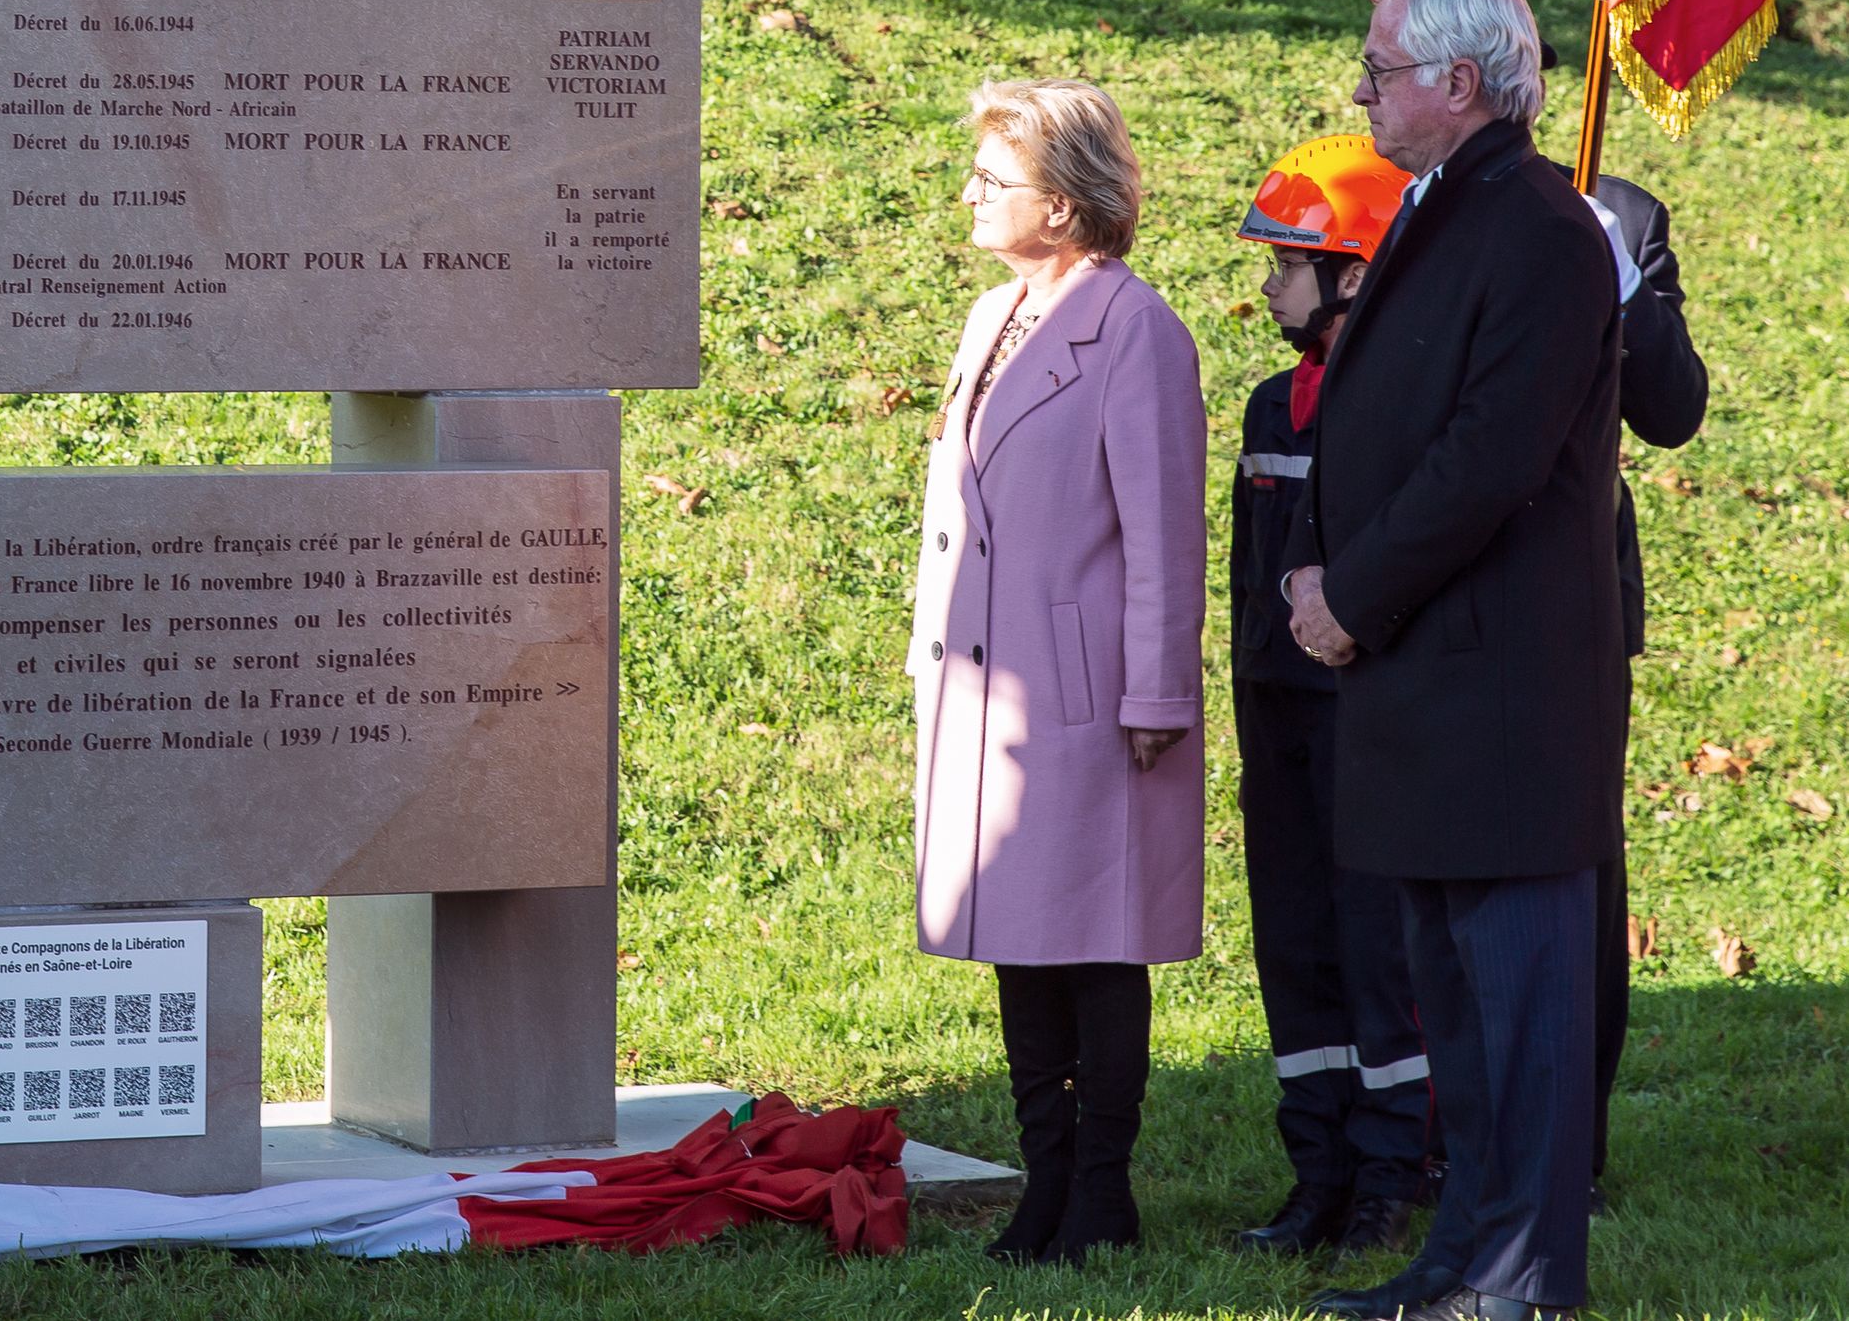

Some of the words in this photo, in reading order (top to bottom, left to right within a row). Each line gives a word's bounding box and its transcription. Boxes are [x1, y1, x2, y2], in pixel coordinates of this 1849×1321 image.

[559, 31, 651, 47] PATRIAM
[550, 54, 659, 71] SERVANDO
[545, 77, 666, 94] VICTORIAM
[574, 102, 637, 118] TULIT
[556, 184, 580, 199] En
[593, 186, 655, 200] servant
[566, 208, 581, 223] la
[595, 208, 646, 228] patrie
[545, 231, 557, 247] il
[570, 236, 579, 247] a
[593, 231, 669, 252] remporté
[558, 255, 573, 270] la
[587, 255, 652, 270] victoire
[6, 539, 23, 556] la
[33, 536, 141, 557] Libération,
[152, 536, 203, 554] ordre
[214, 534, 291, 557] français
[299, 533, 338, 551] créé
[349, 537, 381, 555] par
[387, 532, 403, 549] le
[413, 531, 483, 554] général
[490, 531, 510, 547] de
[521, 528, 607, 549] GAULLE,
[122, 613, 151, 632] les
[169, 616, 278, 636] personnes
[294, 615, 320, 628] ou
[337, 609, 366, 627] les
[383, 605, 511, 627] collectivités
[17, 657, 36, 674] et
[55, 654, 125, 673] civiles
[143, 652, 178, 677] qui
[194, 656, 216, 670] se
[233, 652, 299, 670] seront
[316, 647, 415, 673] signalées
[12, 942, 90, 956] Compagnons
[94, 939, 108, 951] de
[112, 938, 122, 950] la
[126, 937, 185, 950] Libération
[0, 961, 21, 973] nés
[25, 963, 39, 972] en
[43, 957, 132, 972] Saône-et-Loire
